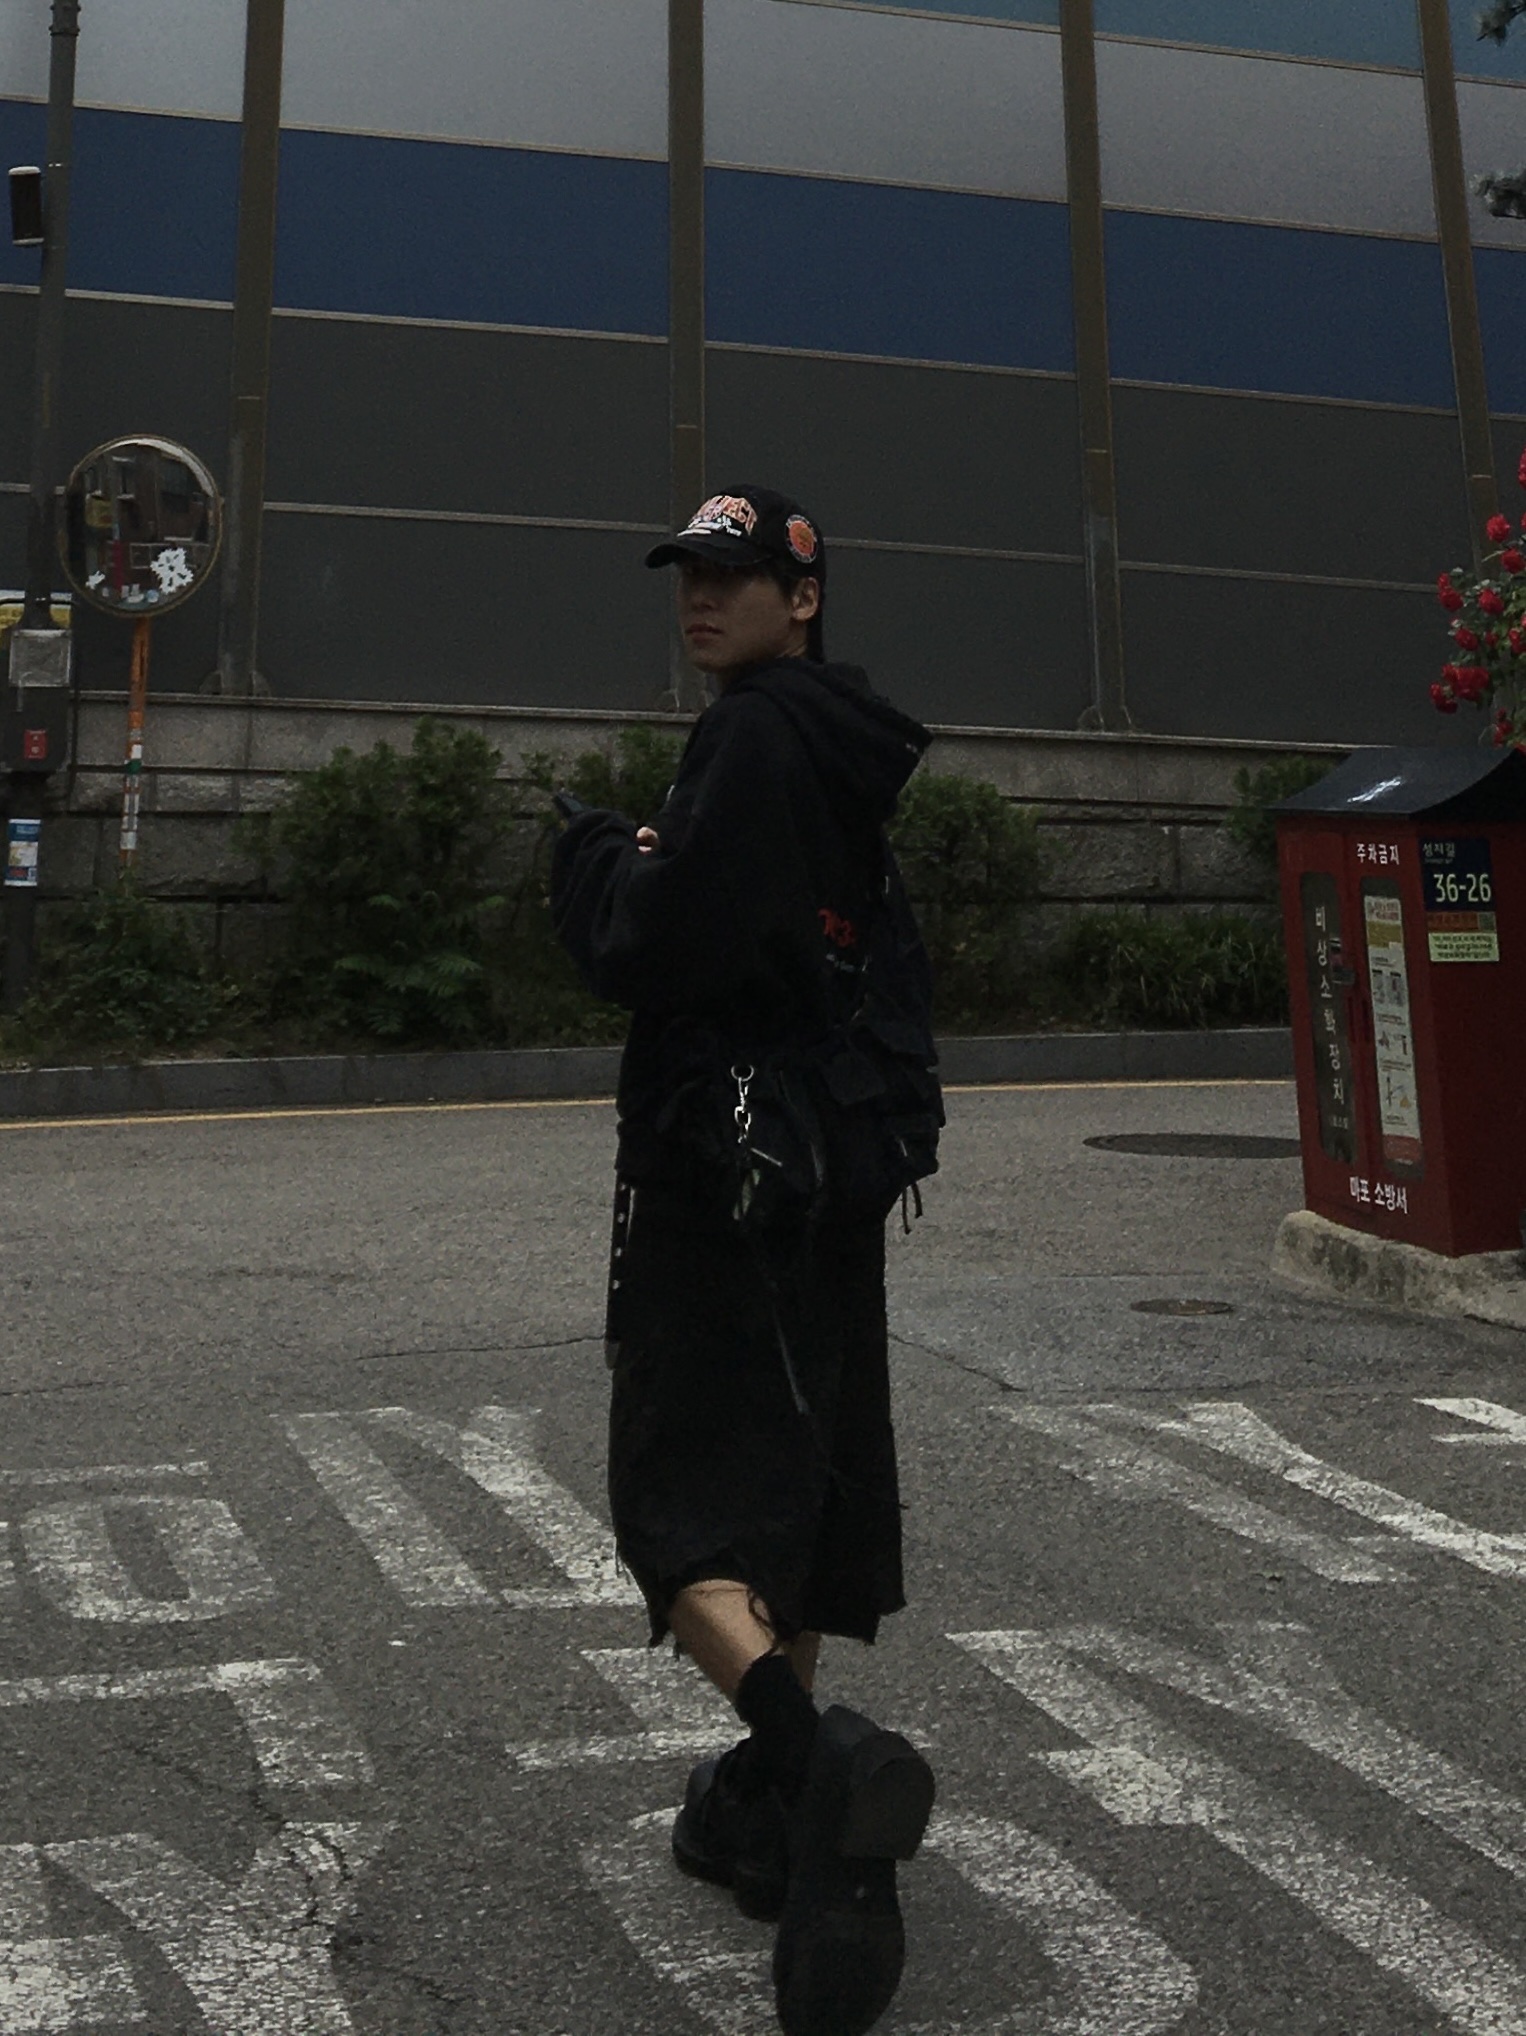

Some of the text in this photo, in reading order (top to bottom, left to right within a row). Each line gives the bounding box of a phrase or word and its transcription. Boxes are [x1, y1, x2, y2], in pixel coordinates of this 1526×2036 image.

[1356, 843, 1400, 865] 주차금지
[1433, 873, 1492, 903] 36-26
[1315, 905, 1344, 1105] 비상소화장치
[1349, 1175, 1408, 1214] 마포 소방서
